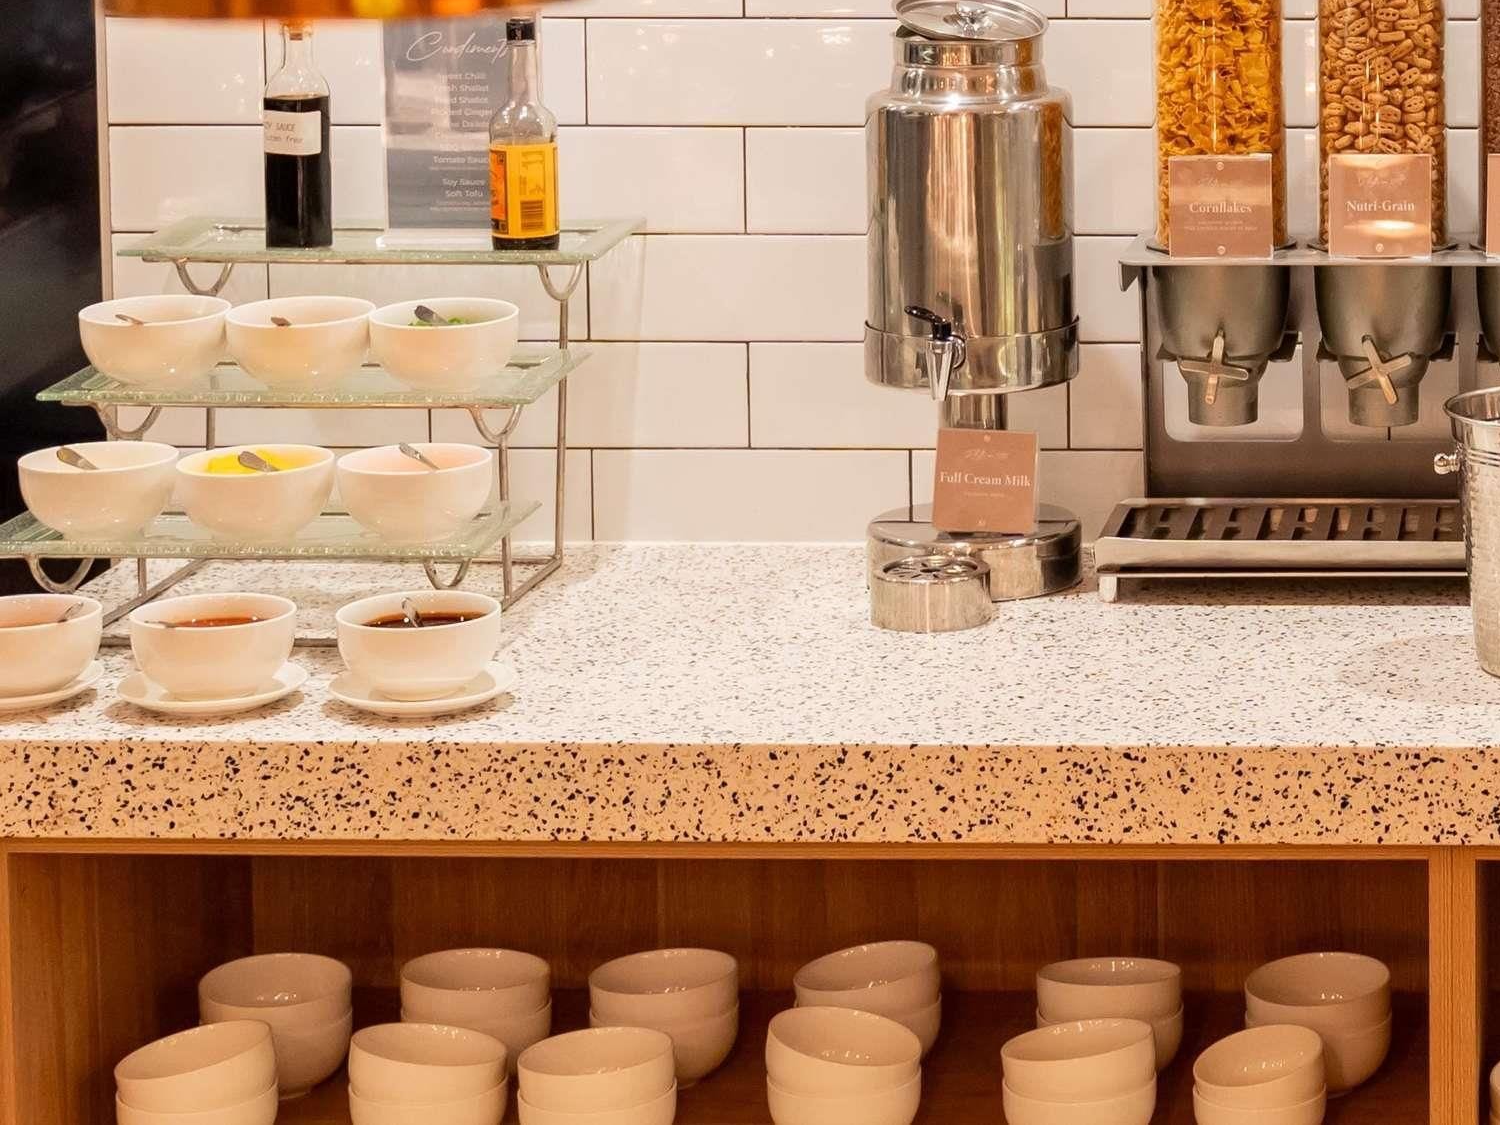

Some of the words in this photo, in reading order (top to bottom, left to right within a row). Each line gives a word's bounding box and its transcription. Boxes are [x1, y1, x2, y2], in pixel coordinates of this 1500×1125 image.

[1188, 200, 1252, 213] Cornflakes
[1345, 200, 1415, 212] Nutri-Grain
[939, 471, 962, 483] Full
[964, 473, 1001, 485] Cream
[1003, 475, 1031, 487] Milk
